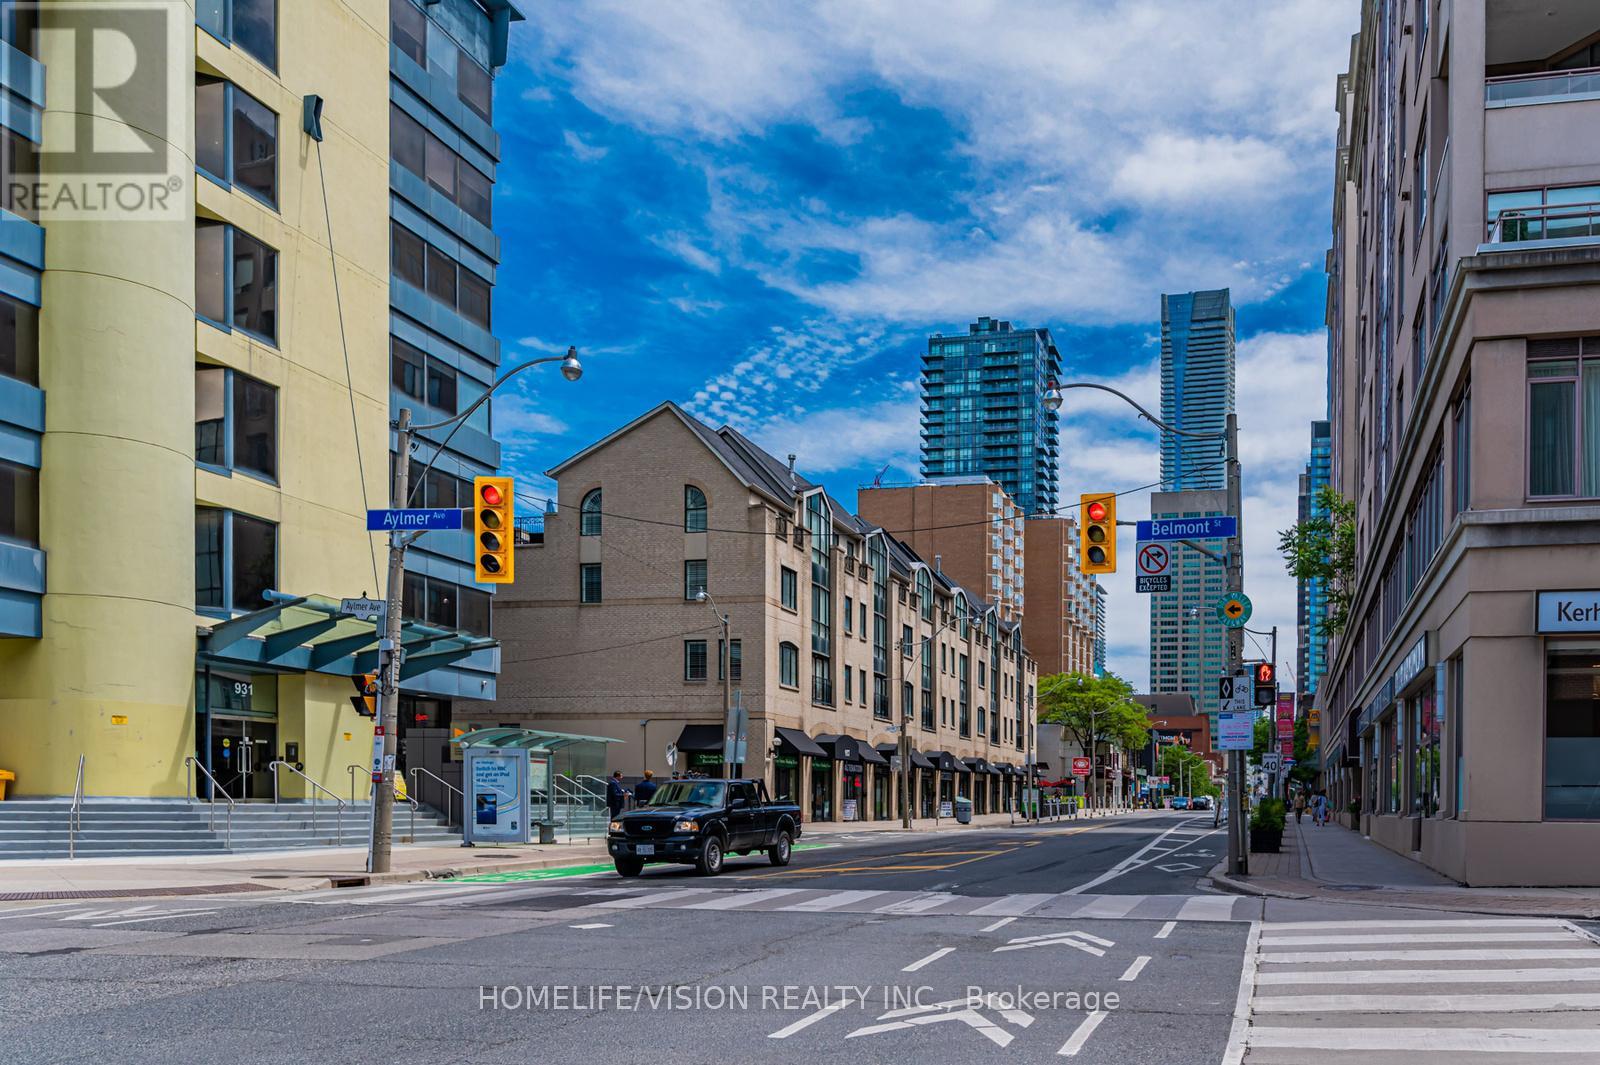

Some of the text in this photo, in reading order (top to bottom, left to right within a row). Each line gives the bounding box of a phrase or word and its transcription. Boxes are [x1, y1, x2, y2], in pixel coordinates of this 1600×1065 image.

[383, 511, 446, 528] Aylmer Ave
[1151, 520, 1210, 536] Belmont
[1140, 576, 1168, 584] BICYCLES
[346, 602, 381, 612] Aylmer Ave
[234, 682, 253, 696] 931
[1263, 761, 1277, 771] 40
